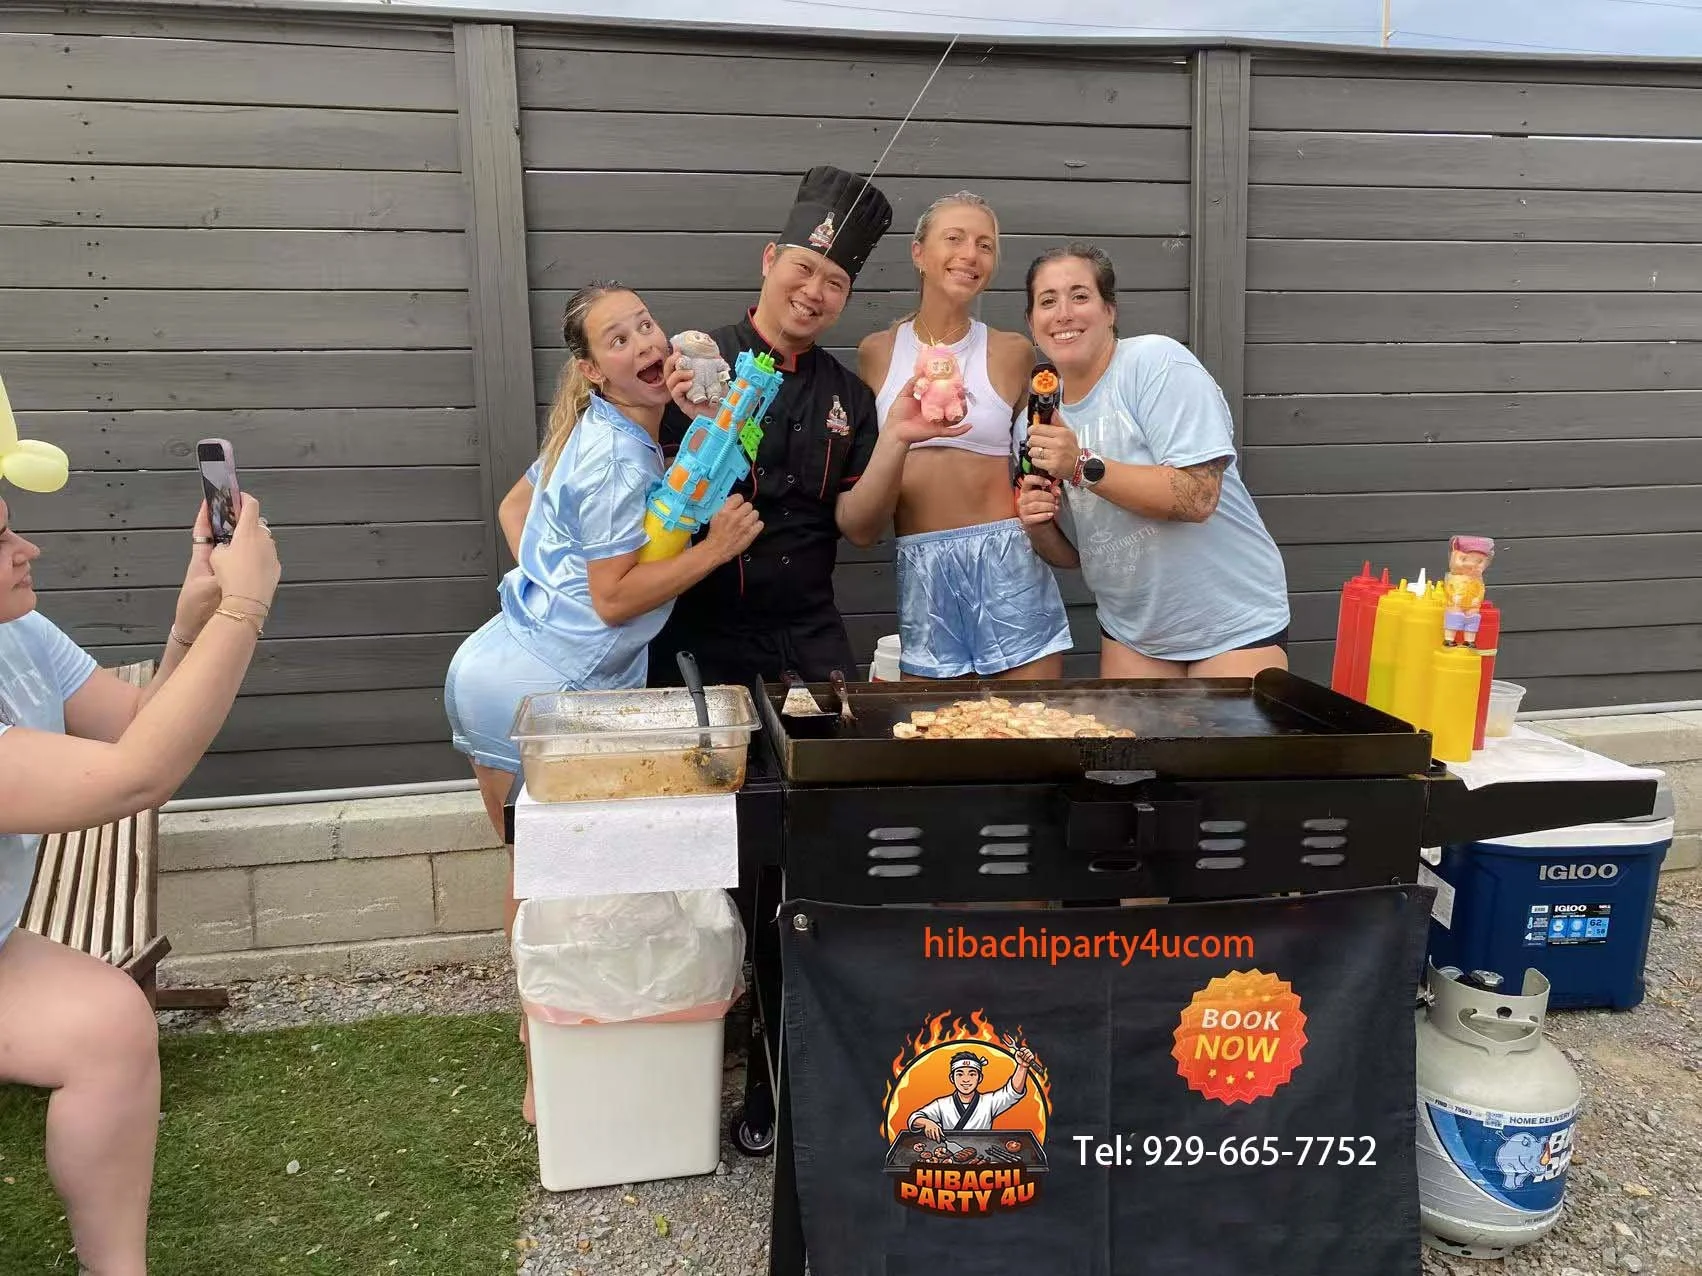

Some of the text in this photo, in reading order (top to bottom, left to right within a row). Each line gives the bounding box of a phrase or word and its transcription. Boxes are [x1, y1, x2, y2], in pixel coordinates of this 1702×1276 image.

[1539, 863, 1618, 880] IGLOO
[1554, 904, 1587, 912] IGLOO
[924, 926, 1255, 966] hibachiparty4ucom
[1202, 1008, 1281, 1030] BOOK
[1194, 1034, 1281, 1063] NOW
[1509, 1116, 1537, 1125] HOME
[1539, 1111, 1570, 1124] DELIVERY
[1073, 1134, 1377, 1166] Tel: 929-665-7752
[916, 1168, 1021, 1191] HIBACHI
[901, 1181, 1036, 1213] PARTY 4U
